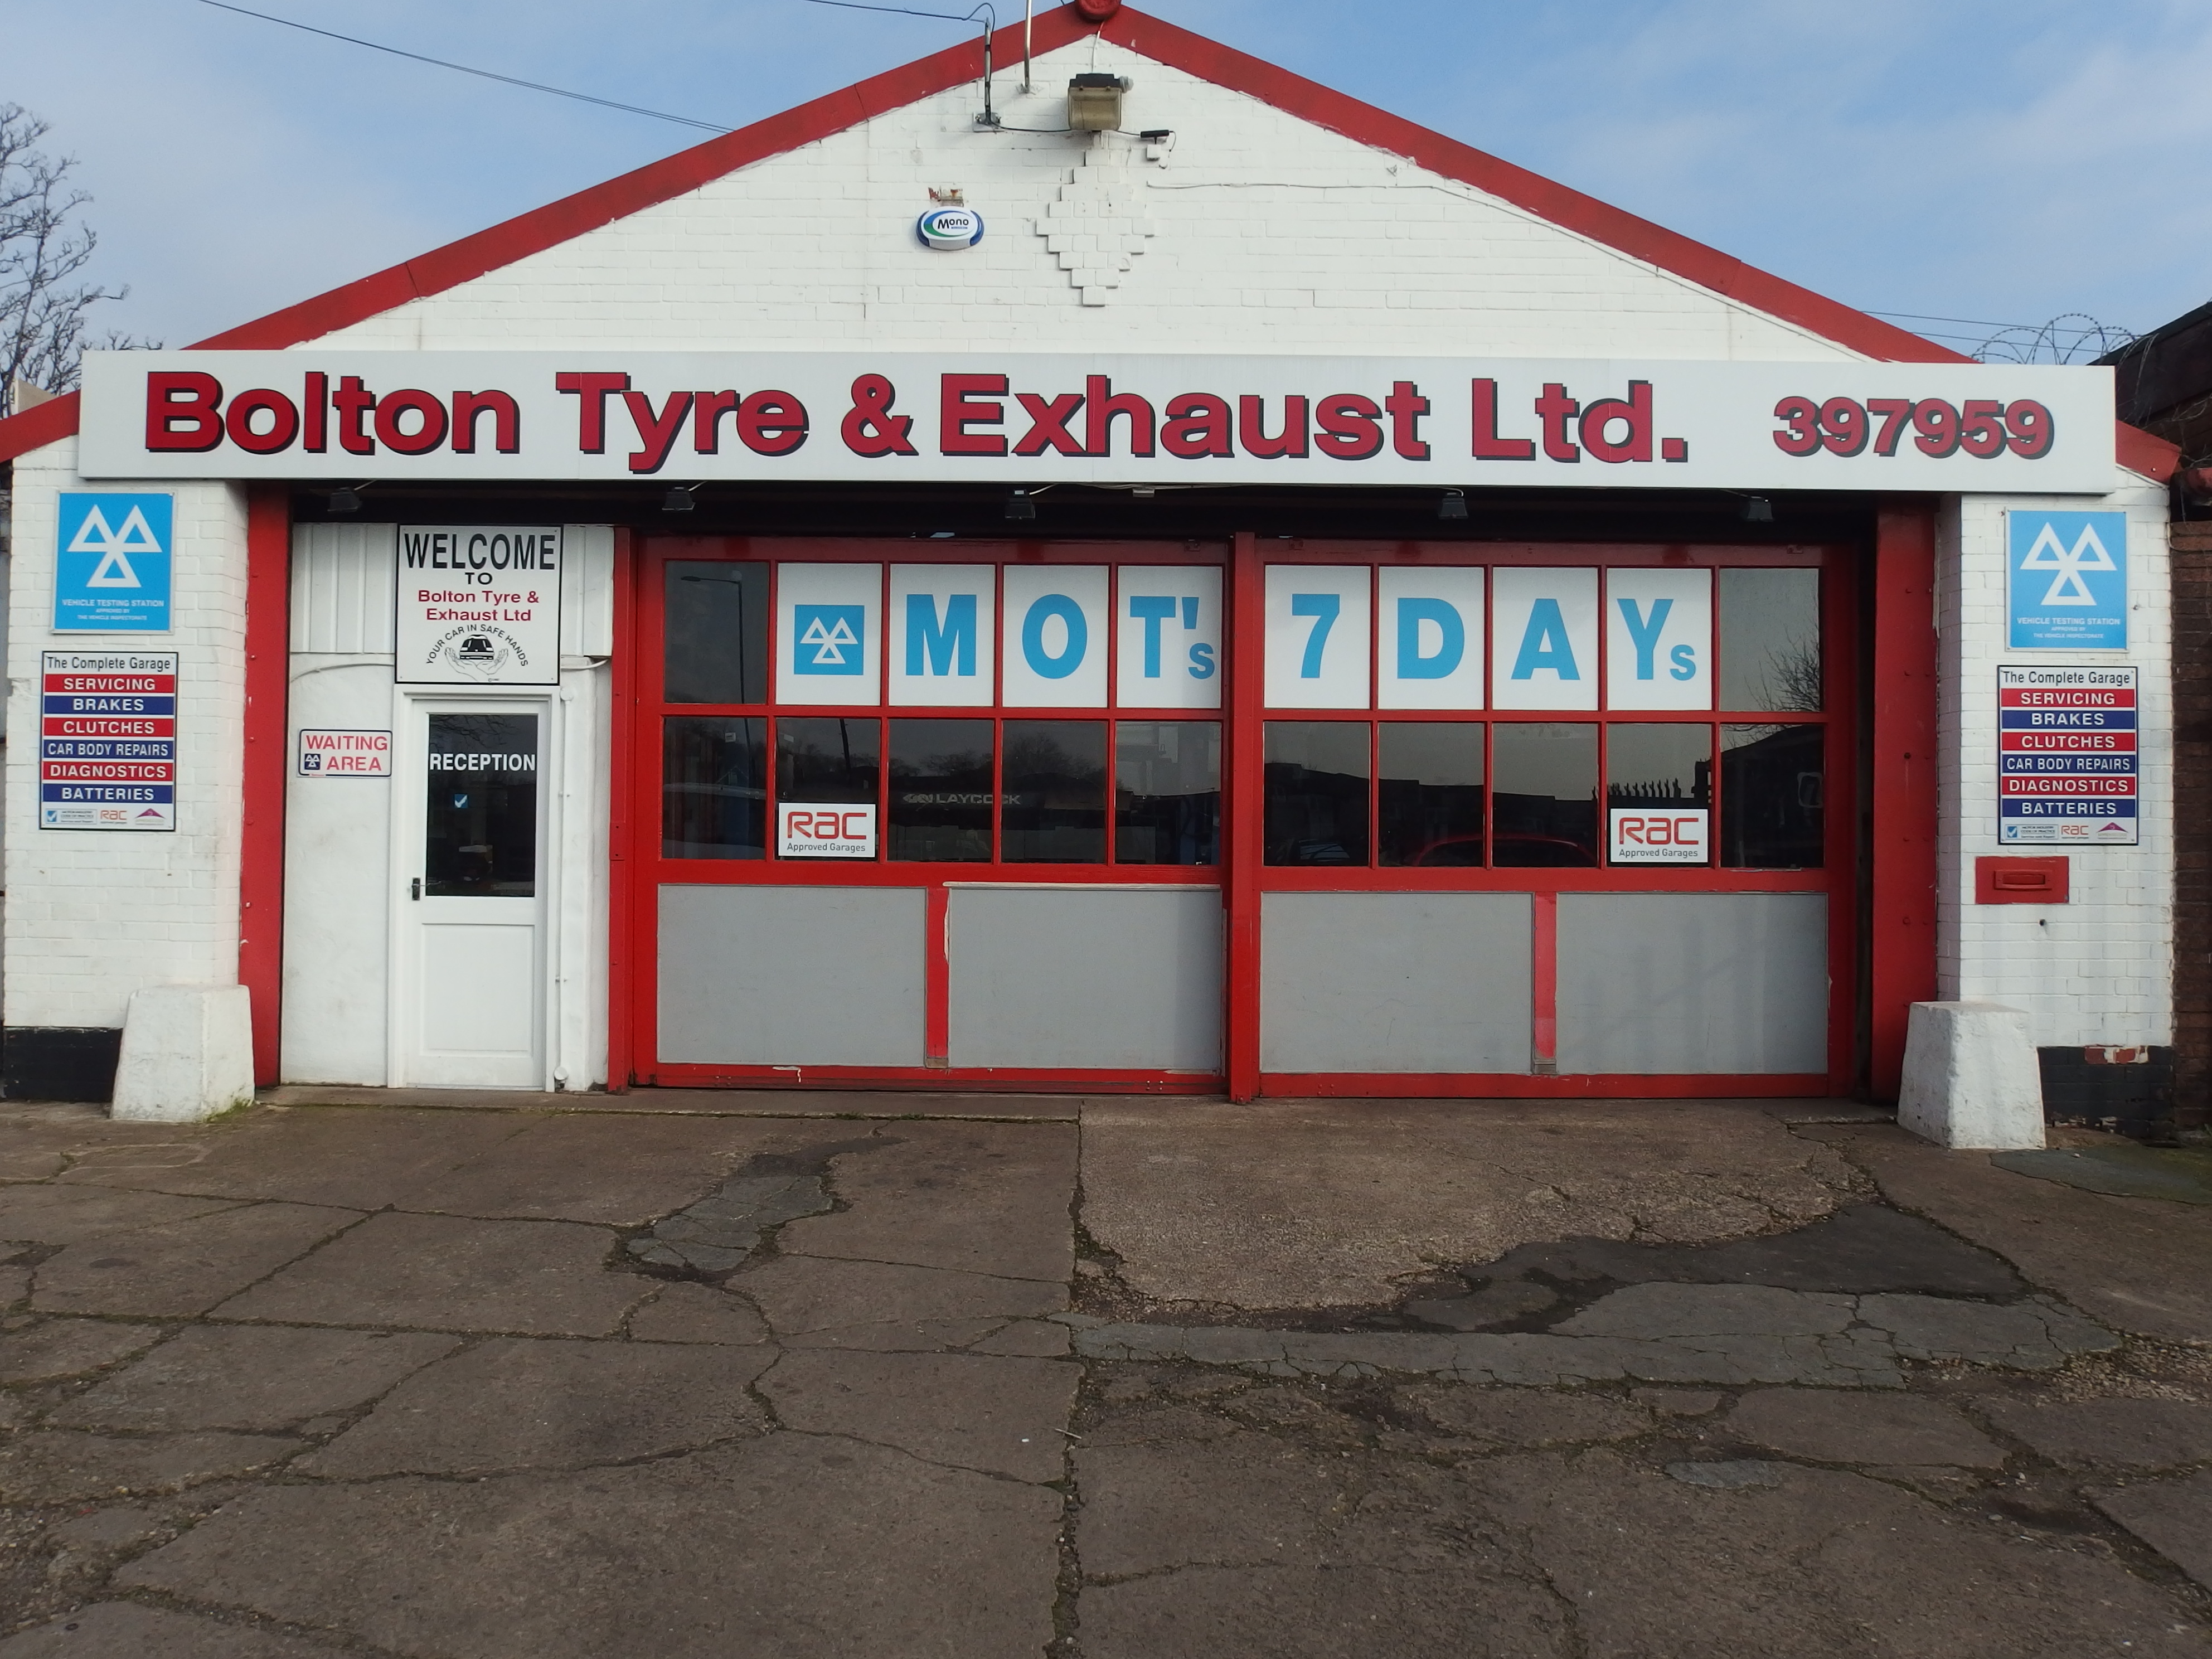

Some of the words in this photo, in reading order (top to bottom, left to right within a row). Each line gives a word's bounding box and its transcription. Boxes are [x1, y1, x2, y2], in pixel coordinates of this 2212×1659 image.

[938, 219, 969, 229] Mono
[145, 371, 520, 455] Bolton
[555, 371, 809, 475] Tyre
[840, 373, 919, 458] &
[939, 372, 1430, 461] Exhaust
[1471, 377, 1687, 463] Ltd.
[1772, 396, 2054, 459] 397959
[404, 533, 556, 570] WELCOME
[465, 572, 493, 585] TO
[418, 590, 476, 603] Bolton
[482, 590, 521, 606] Tyre
[527, 591, 539, 603] &
[426, 608, 497, 620] Exhaust
[504, 609, 531, 621] Ltd
[1292, 594, 1341, 679] 7
[426, 639, 445, 666] YOUR
[445, 627, 465, 641] CAR
[481, 624, 505, 638] SAFE
[505, 635, 528, 667] HANDS
[47, 657, 67, 668] The
[72, 657, 125, 671] Complete
[129, 657, 170, 672] Garage
[64, 678, 156, 690] SERVICING
[2004, 671, 2024, 683] The
[2029, 671, 2084, 686] Complete
[2088, 672, 2129, 686] Garage
[73, 698, 144, 711] BRAKES
[2021, 692, 2115, 705] SERVICING
[2031, 713, 2104, 725] BRAKES
[63, 721, 154, 734] CLUTCHES
[305, 735, 387, 751] WAITING
[2021, 735, 2116, 748] CLUTCHES
[48, 743, 73, 755] CAR
[77, 744, 111, 755] BODY
[116, 744, 168, 756] REPAIRS
[326, 756, 382, 771] AREA
[429, 753, 535, 771] RECEPTION
[2007, 758, 2032, 770] CAR
[2038, 758, 2072, 770] BODY
[2077, 758, 2130, 770] REPAIRS
[50, 765, 166, 778] DIAGNOSTICS
[2009, 779, 2128, 792] DIAGNOSTICS
[61, 787, 154, 800] BATTERIES
[2021, 802, 2116, 814] BATTERIES
[787, 842, 827, 852] Approved
[830, 843, 866, 853] Garages
[1619, 848, 1660, 858] Approved
[1662, 848, 1698, 858] Garages
